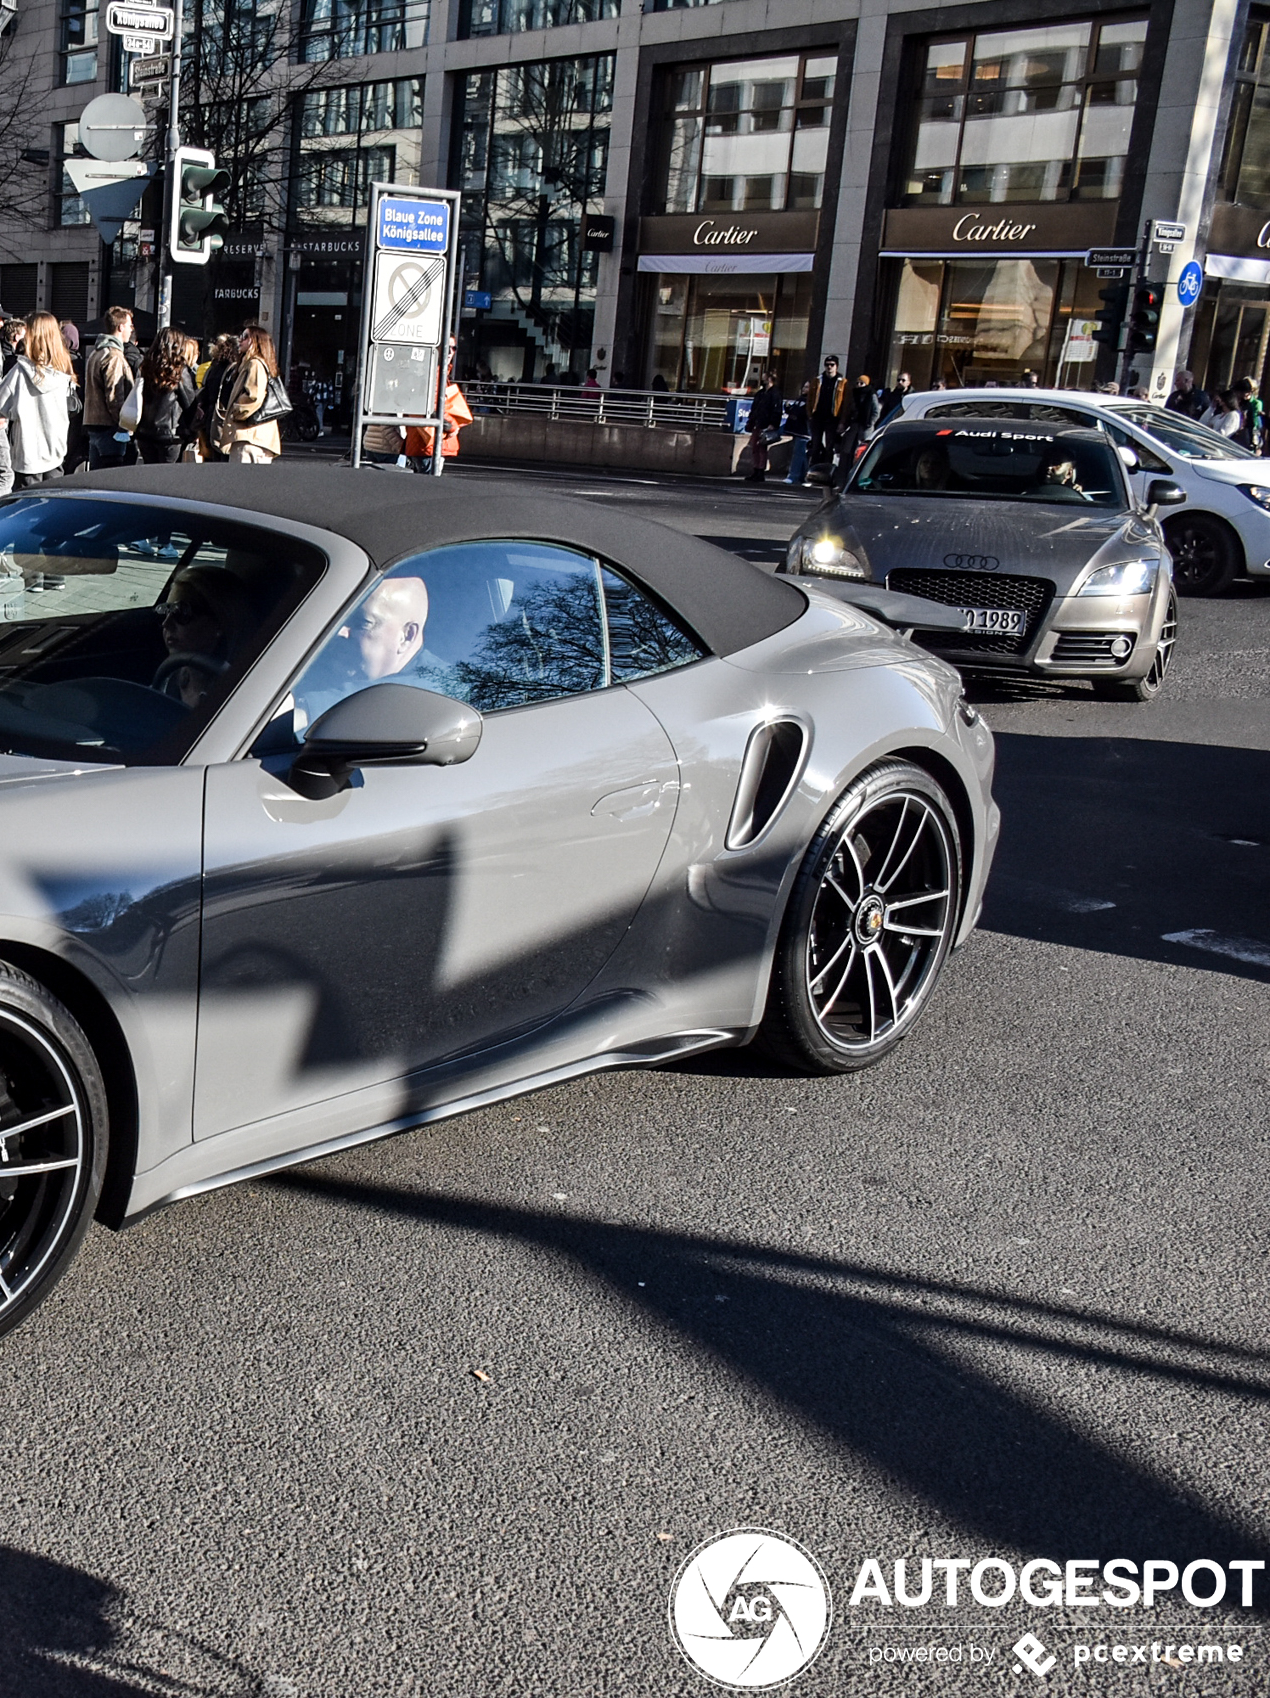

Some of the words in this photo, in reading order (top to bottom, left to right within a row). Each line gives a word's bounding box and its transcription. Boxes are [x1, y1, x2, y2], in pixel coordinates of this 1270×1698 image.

[384, 208, 415, 224] Blaue
[417, 210, 443, 226] Zone
[382, 224, 444, 243] Königsallee
[587, 228, 610, 239] Cartier
[693, 220, 758, 245] Cartier
[952, 213, 1036, 241] Cartier
[303, 241, 360, 252] STARBUCKS
[1092, 253, 1131, 263] Steinstraße
[704, 260, 738, 272] Cartier
[390, 323, 423, 338] ZONE
[954, 430, 997, 438] Audi
[1000, 432, 1054, 442] Sport
[978, 611, 1022, 630] 1989
